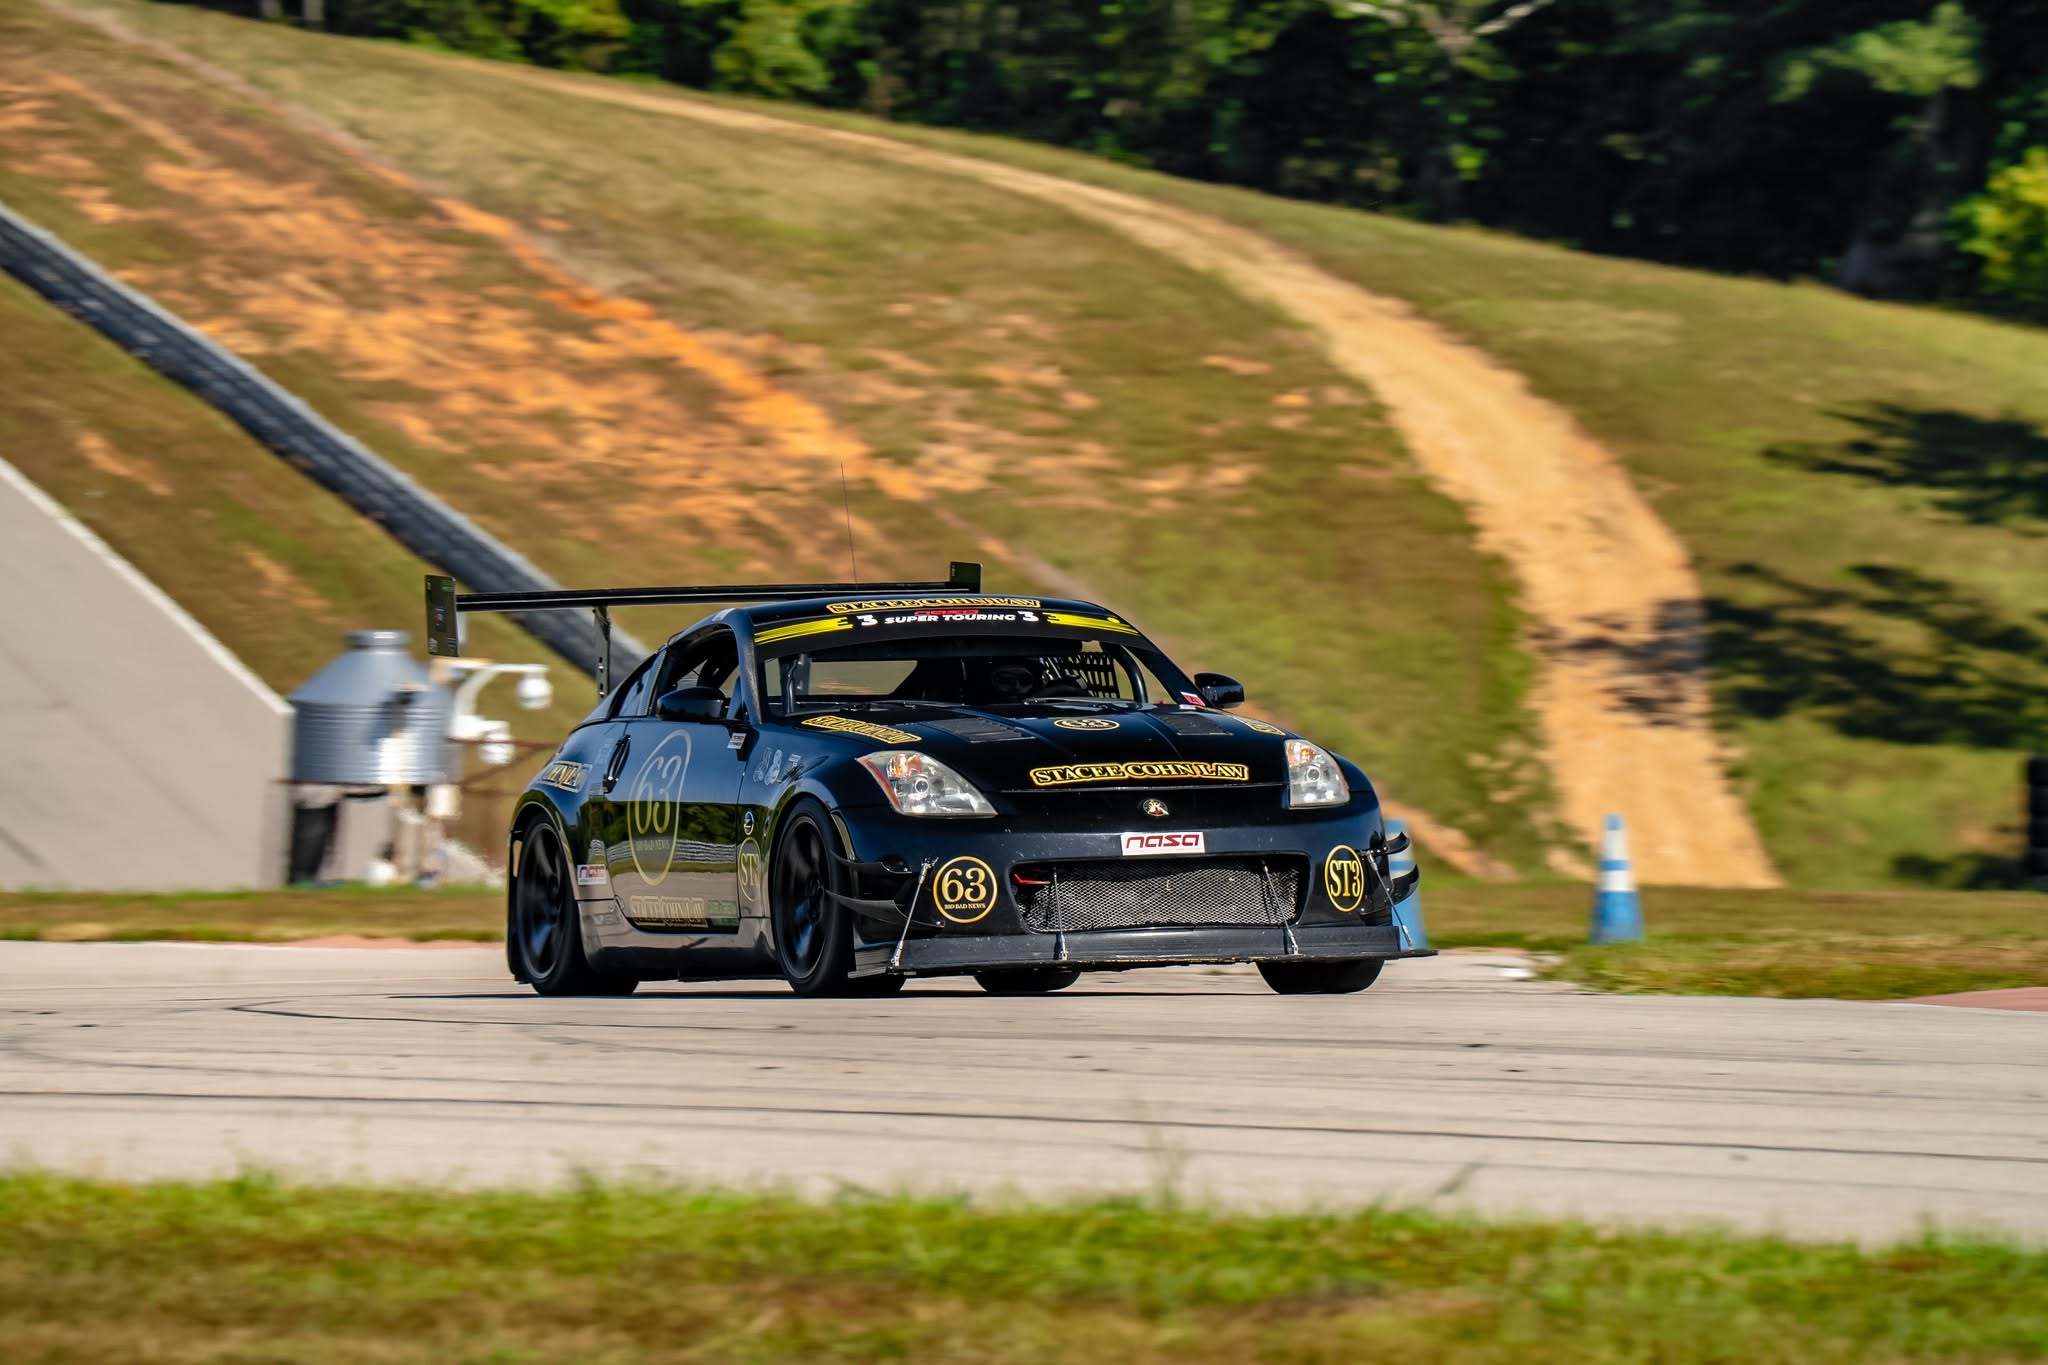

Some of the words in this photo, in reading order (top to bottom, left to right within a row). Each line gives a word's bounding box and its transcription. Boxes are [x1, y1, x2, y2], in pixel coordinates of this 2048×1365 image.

[856, 614, 878, 626] 3
[884, 614, 939, 624] SUPER
[942, 612, 1016, 621] TOURING
[1017, 611, 1040, 622] 3
[1035, 765, 1124, 783] STACEE
[1126, 763, 1193, 777] COHN
[1199, 763, 1246, 778] LAW
[635, 755, 682, 834] 63
[1126, 834, 1200, 849] nasa
[941, 867, 987, 902] 63
[1329, 860, 1361, 898] ST3
